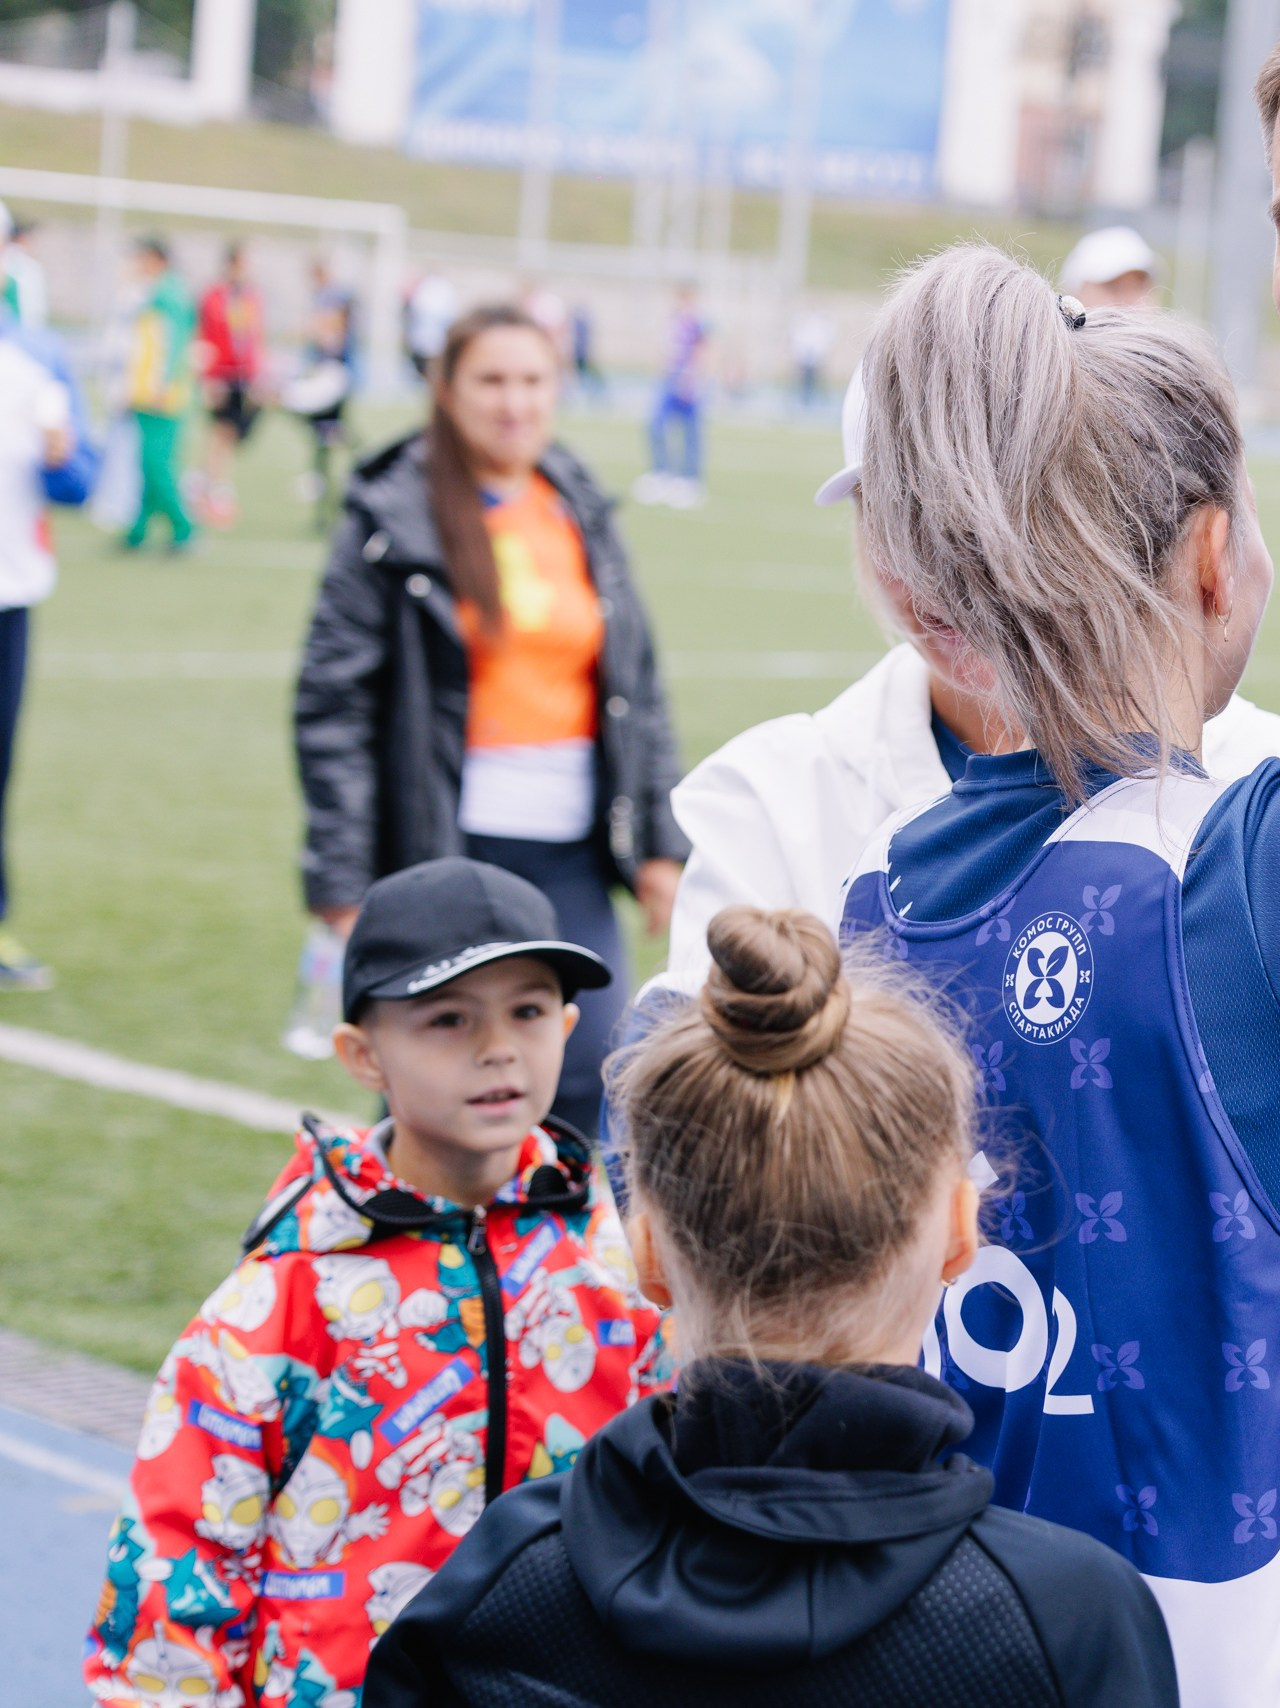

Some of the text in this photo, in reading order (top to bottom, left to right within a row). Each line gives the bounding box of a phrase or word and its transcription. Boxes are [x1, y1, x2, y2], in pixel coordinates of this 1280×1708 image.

[1012, 917, 1087, 959] КОМОС ГРУПП
[1008, 997, 1085, 1039] СПАРТАКИАДА
